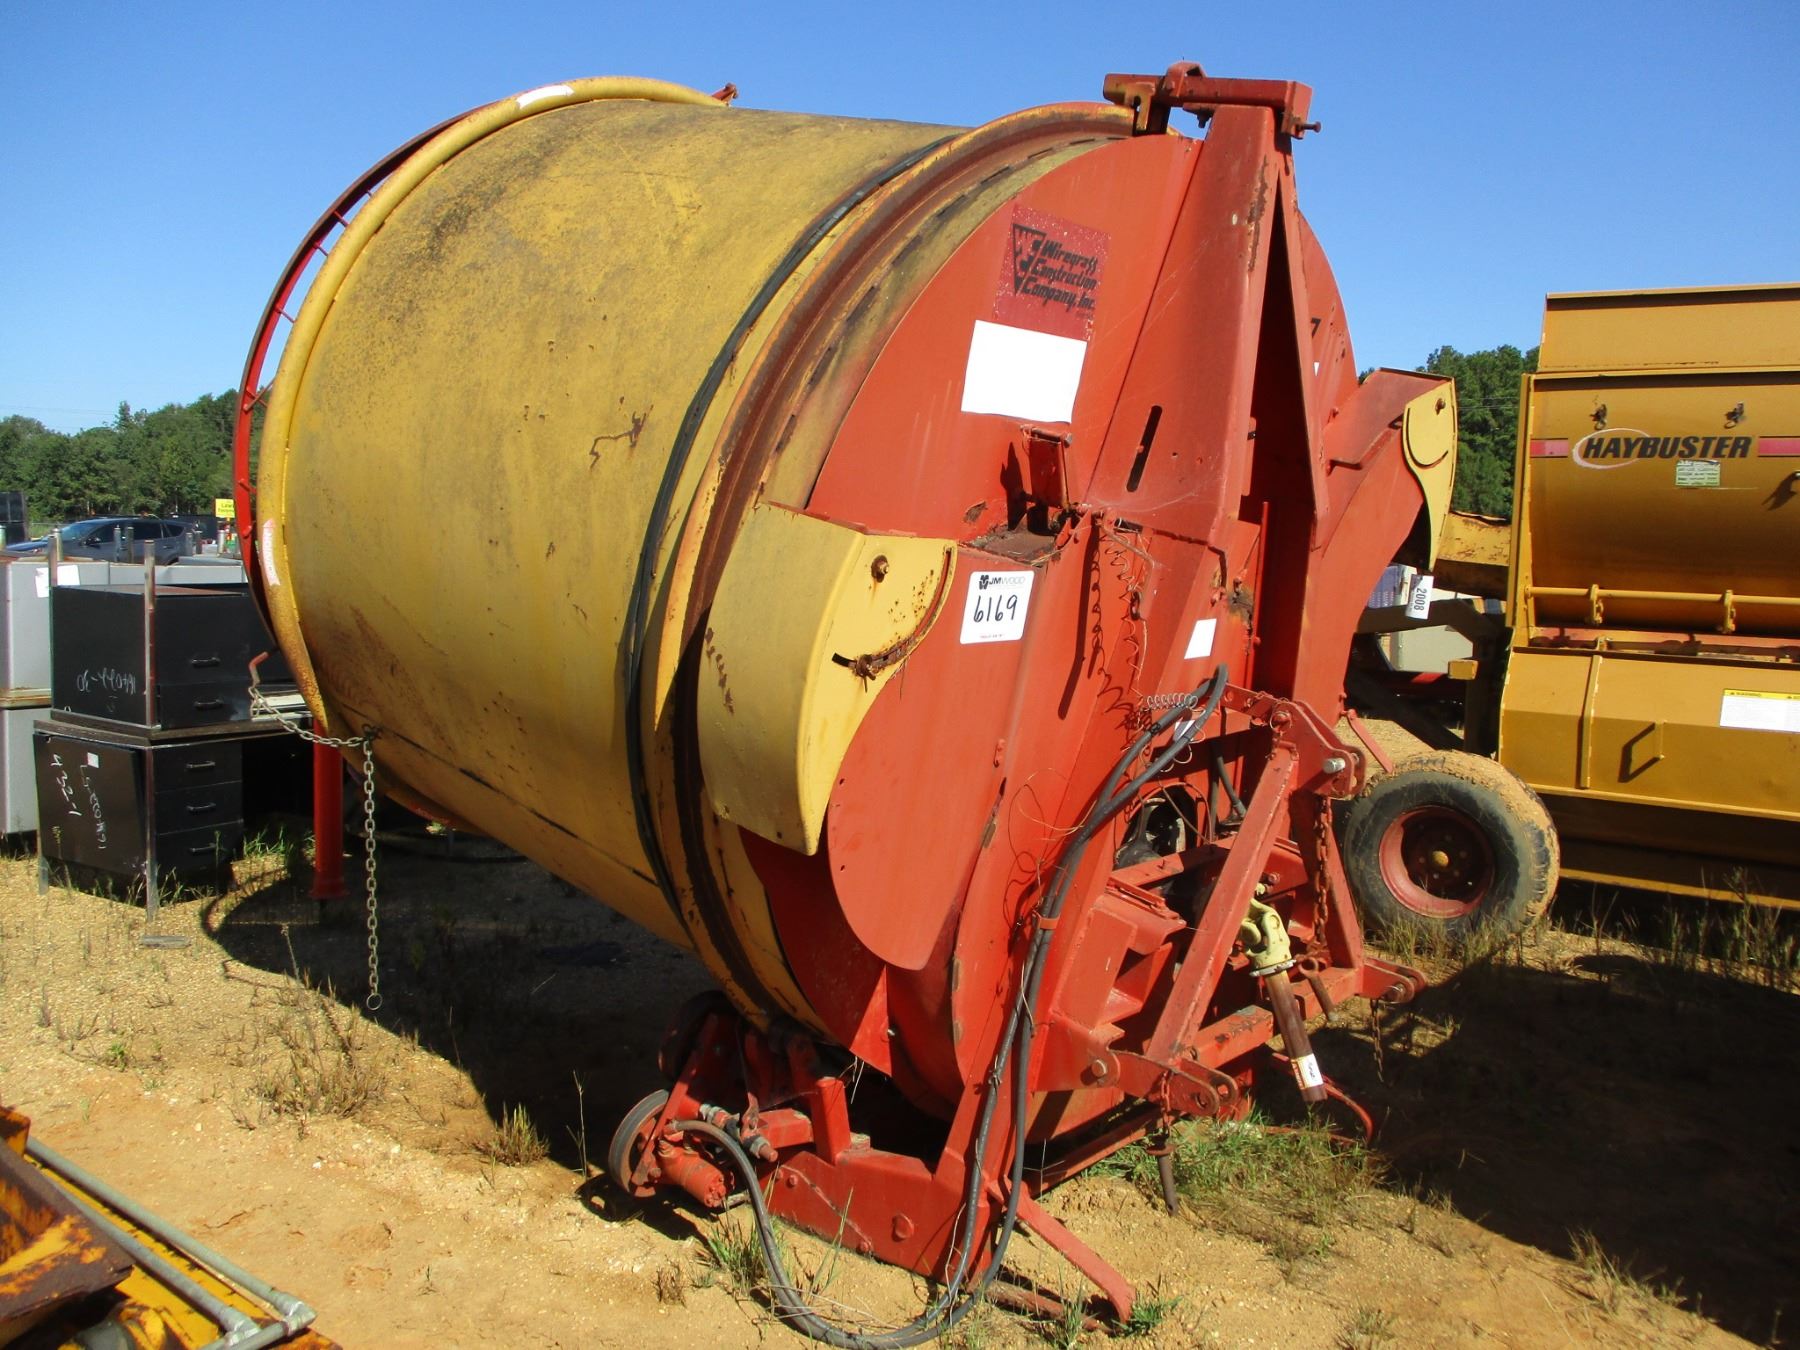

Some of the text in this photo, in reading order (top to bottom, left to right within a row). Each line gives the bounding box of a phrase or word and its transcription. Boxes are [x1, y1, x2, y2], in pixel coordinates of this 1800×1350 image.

[1040, 239, 1098, 276] Wiregrass
[1030, 257, 1097, 291] Construction
[1583, 435, 1752, 459] HAYBUSTER
[973, 594, 1018, 623] 6169
[1413, 587, 1427, 611] 2008
